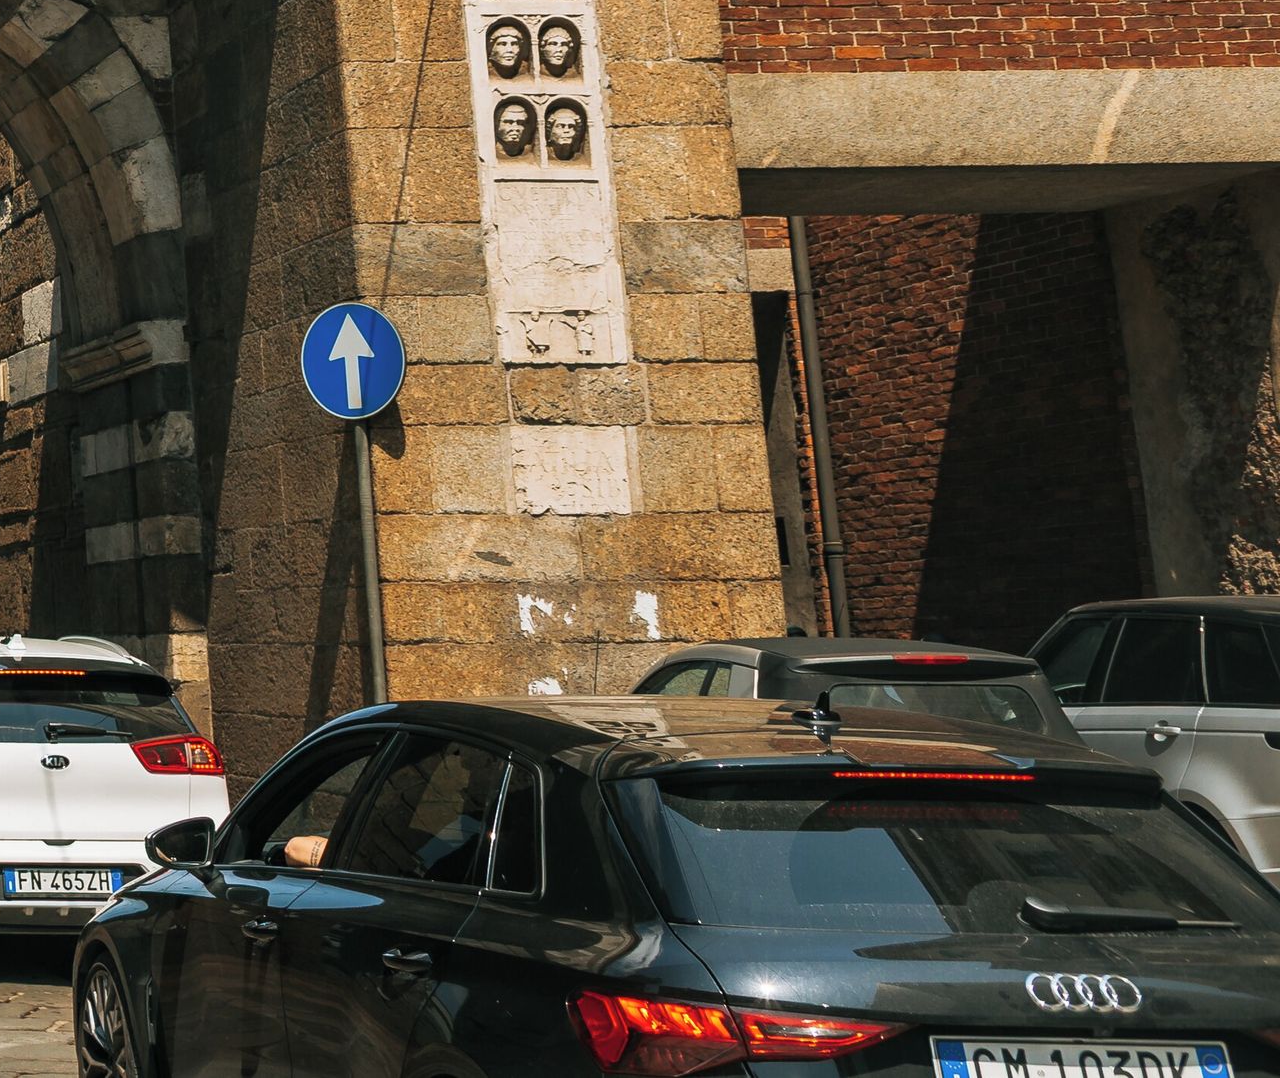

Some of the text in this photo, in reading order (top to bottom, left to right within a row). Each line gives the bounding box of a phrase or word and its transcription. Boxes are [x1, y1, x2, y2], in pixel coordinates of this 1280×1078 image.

[45, 756, 66, 767] KIA
[18, 869, 42, 891] FN
[50, 869, 111, 891] 465ZH
